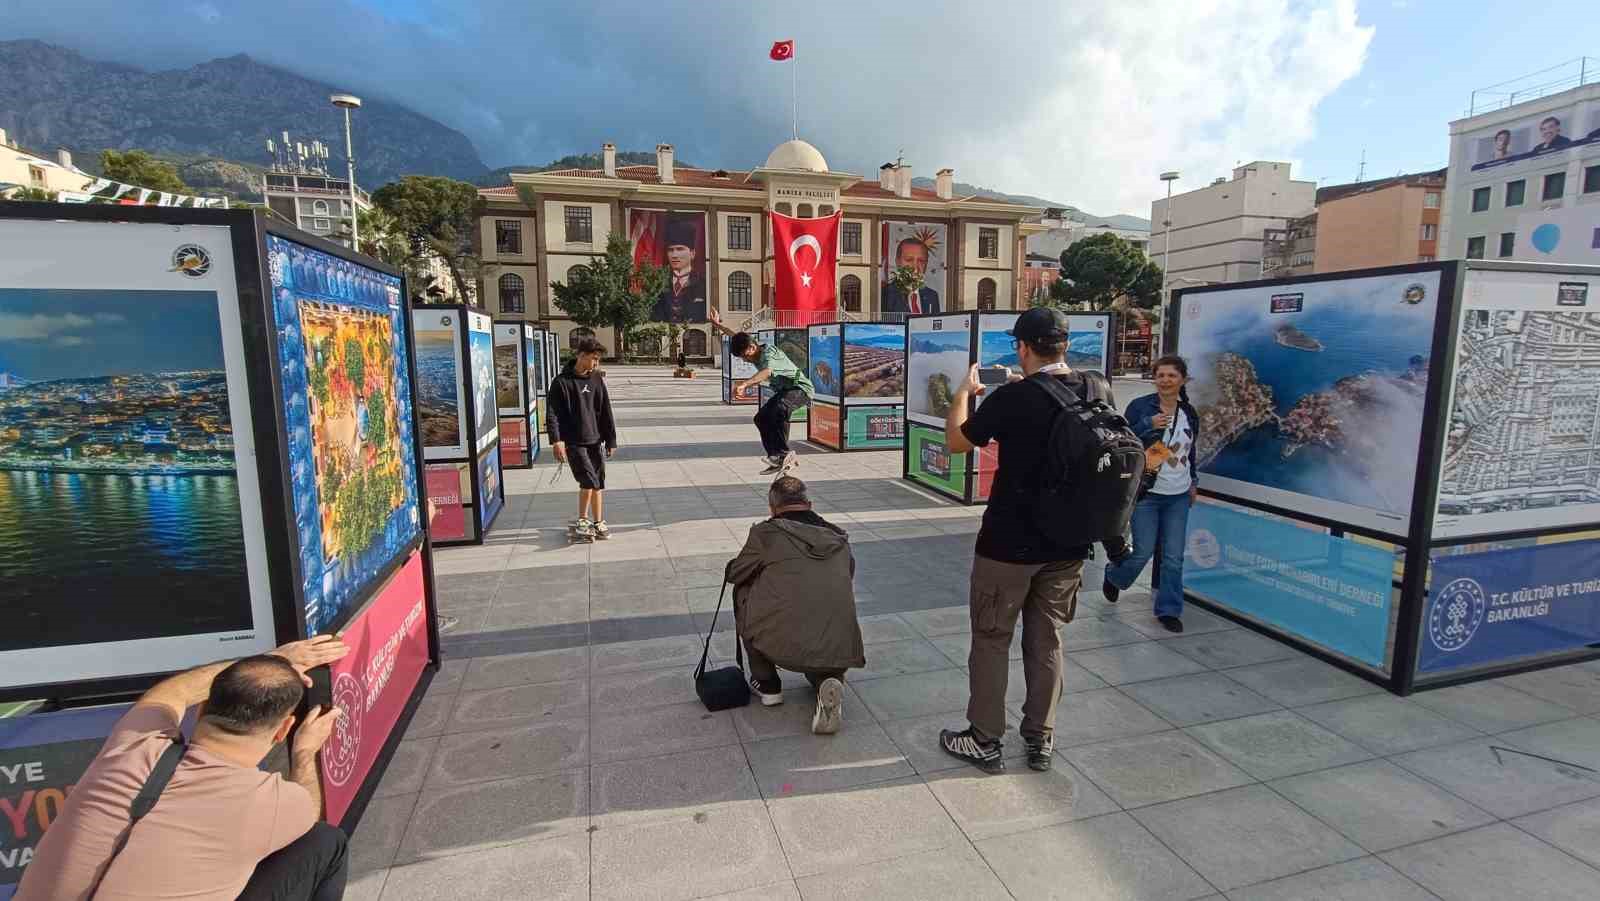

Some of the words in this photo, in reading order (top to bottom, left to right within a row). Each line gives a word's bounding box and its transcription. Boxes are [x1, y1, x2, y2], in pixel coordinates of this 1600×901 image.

[1490, 592, 1510, 606] T.C.
[1511, 584, 1554, 604] KÜLTÜR
[1556, 583, 1570, 597] VE
[1487, 601, 1549, 623] BAKANLIĞI
[0, 761, 45, 784] YE
[0, 786, 75, 838] YO
